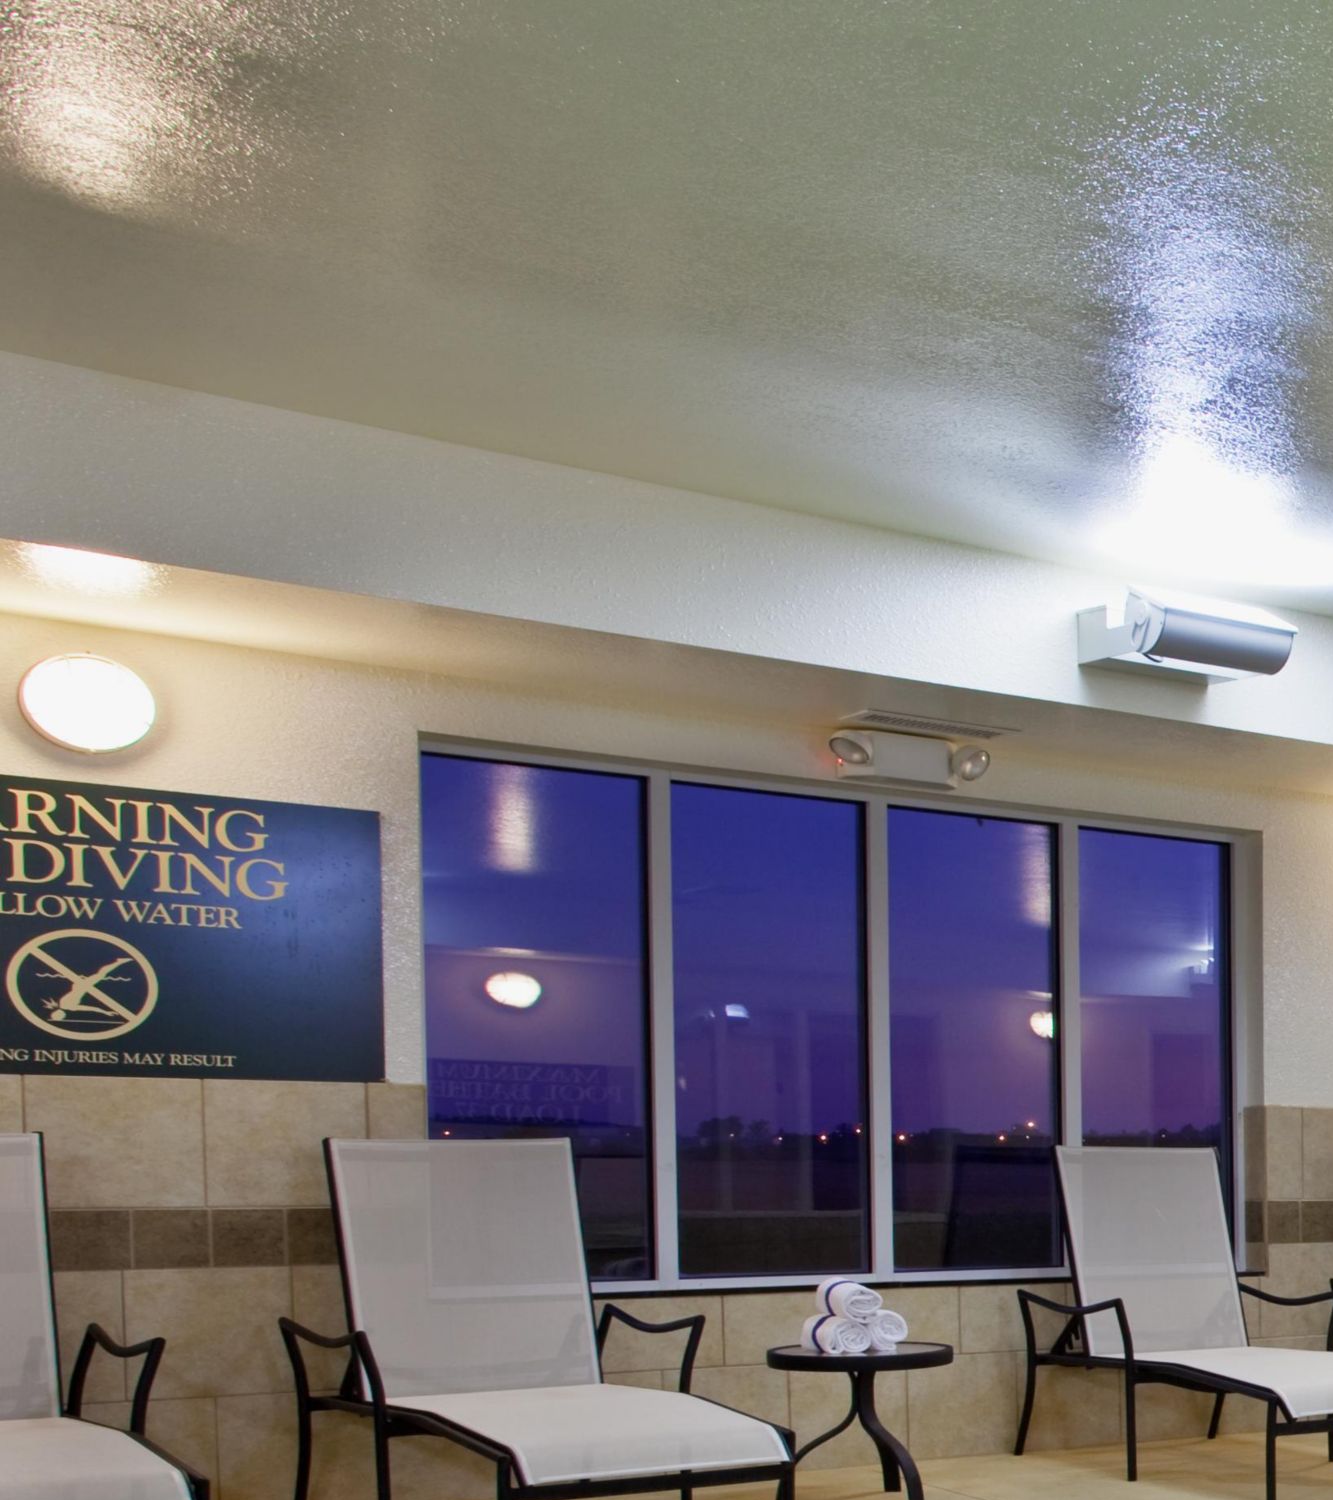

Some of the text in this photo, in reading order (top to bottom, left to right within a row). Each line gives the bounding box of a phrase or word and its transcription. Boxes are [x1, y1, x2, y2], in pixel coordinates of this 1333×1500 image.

[0, 788, 269, 852] RNING
[3, 838, 288, 900] DIVING
[113, 900, 242, 929] WATER
[34, 1049, 119, 1065] INJURIES
[123, 1052, 164, 1066] MAY
[169, 1053, 237, 1067] RESULT
